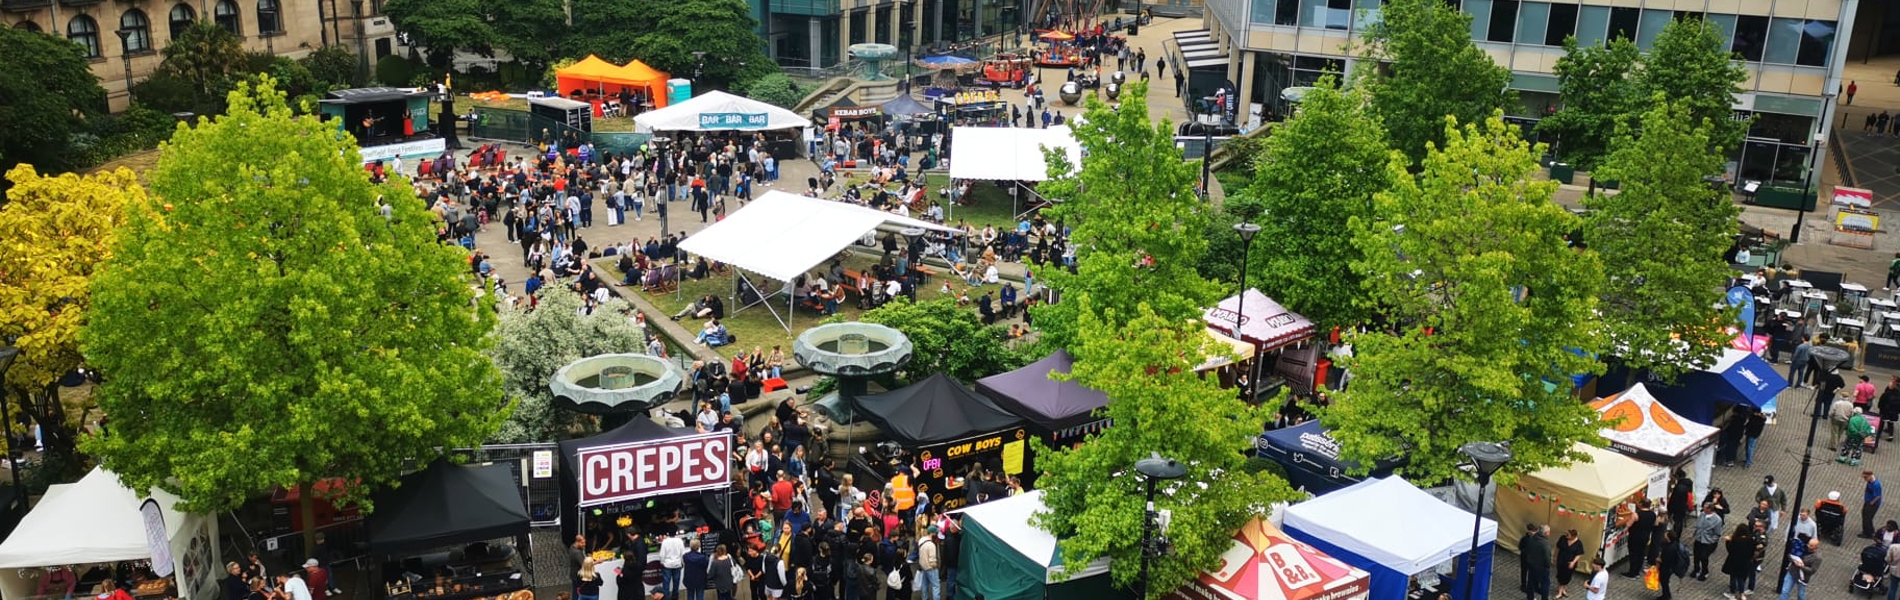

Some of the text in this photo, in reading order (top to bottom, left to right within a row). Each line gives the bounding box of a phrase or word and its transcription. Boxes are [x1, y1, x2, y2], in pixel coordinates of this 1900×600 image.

[858, 107, 877, 115] BOYS
[702, 114, 765, 124] BAR BAR BAR
[947, 443, 973, 457] COW
[975, 436, 1002, 451] BOYS
[586, 440, 725, 496] CREPES
[923, 458, 941, 471] OPEN
